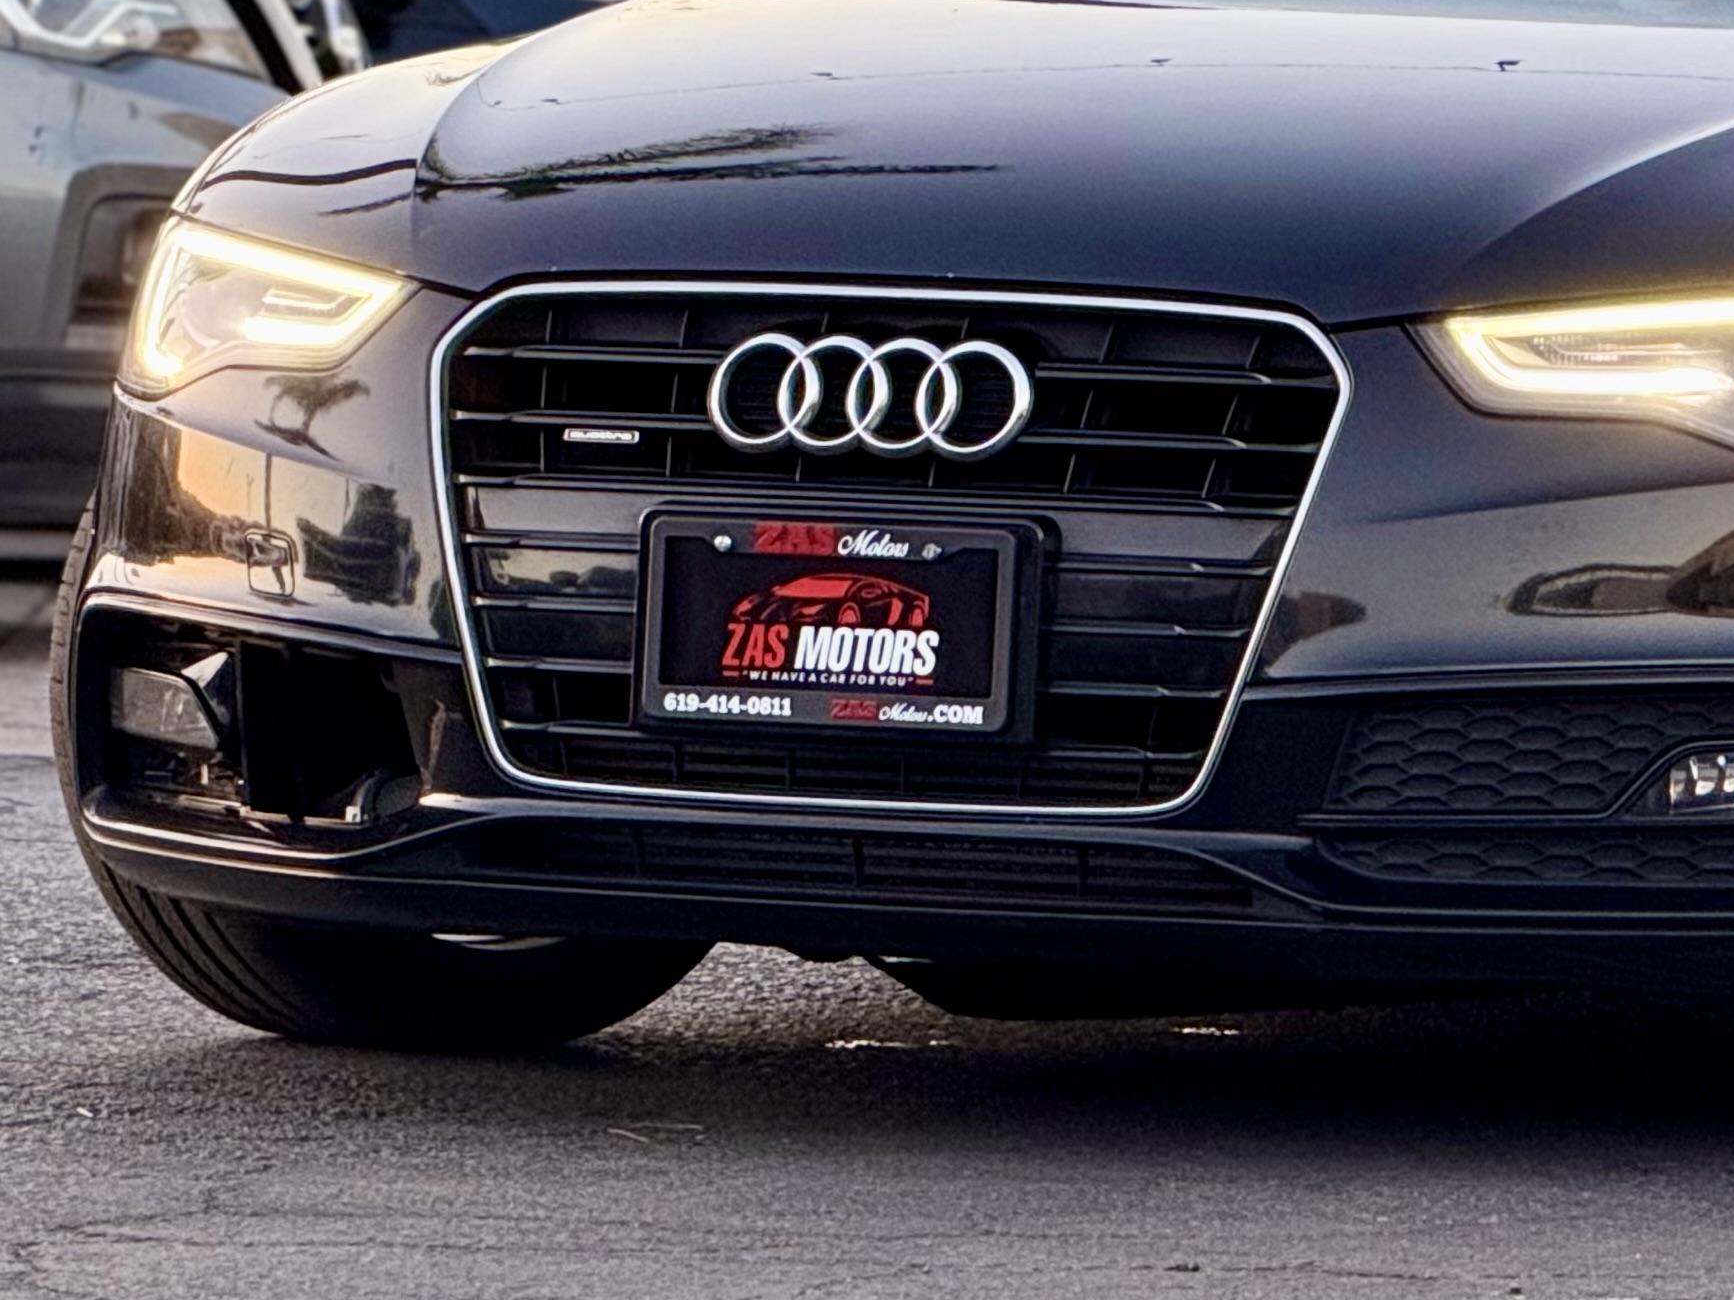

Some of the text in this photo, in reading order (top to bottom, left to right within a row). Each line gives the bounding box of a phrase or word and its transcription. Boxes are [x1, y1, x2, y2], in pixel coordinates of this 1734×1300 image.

[755, 522, 910, 557] ZAS Motors
[721, 622, 940, 676] ZAS MOTORS
[771, 671, 806, 682] HAVE
[807, 673, 817, 682] A
[820, 673, 845, 684] CAR
[849, 674, 876, 685] FOR
[663, 693, 792, 717] 619-414-0811
